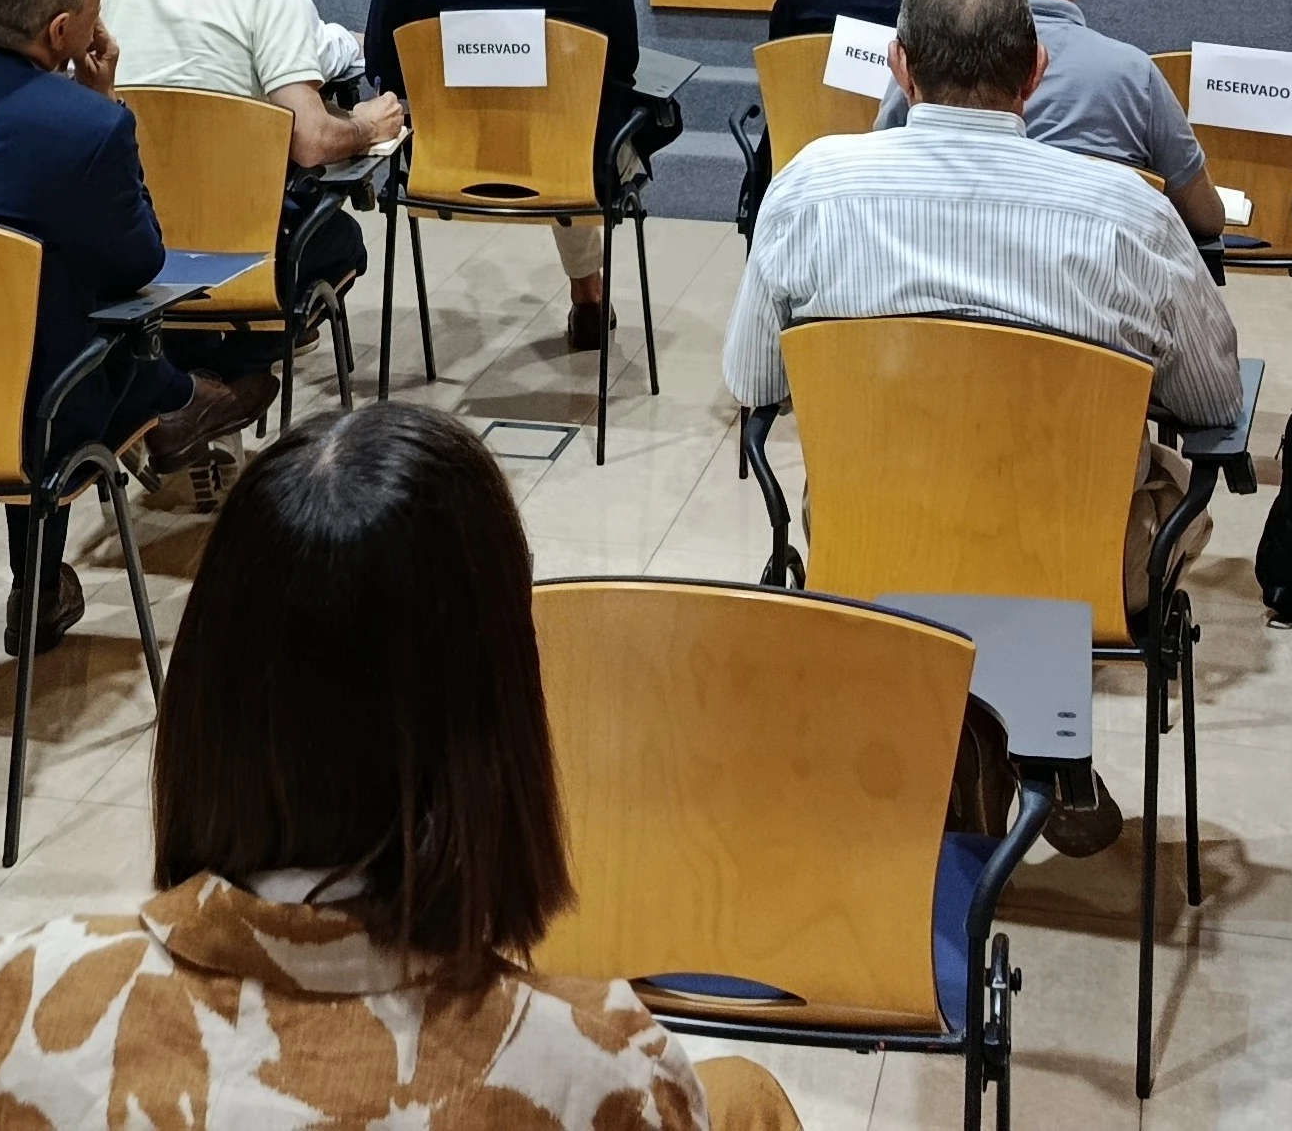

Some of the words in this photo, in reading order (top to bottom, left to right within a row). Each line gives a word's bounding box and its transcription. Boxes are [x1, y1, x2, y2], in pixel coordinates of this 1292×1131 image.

[457, 43, 531, 54] RESERVADO
[846, 46, 886, 66] RESER
[1207, 79, 1290, 99] RESERVADO
